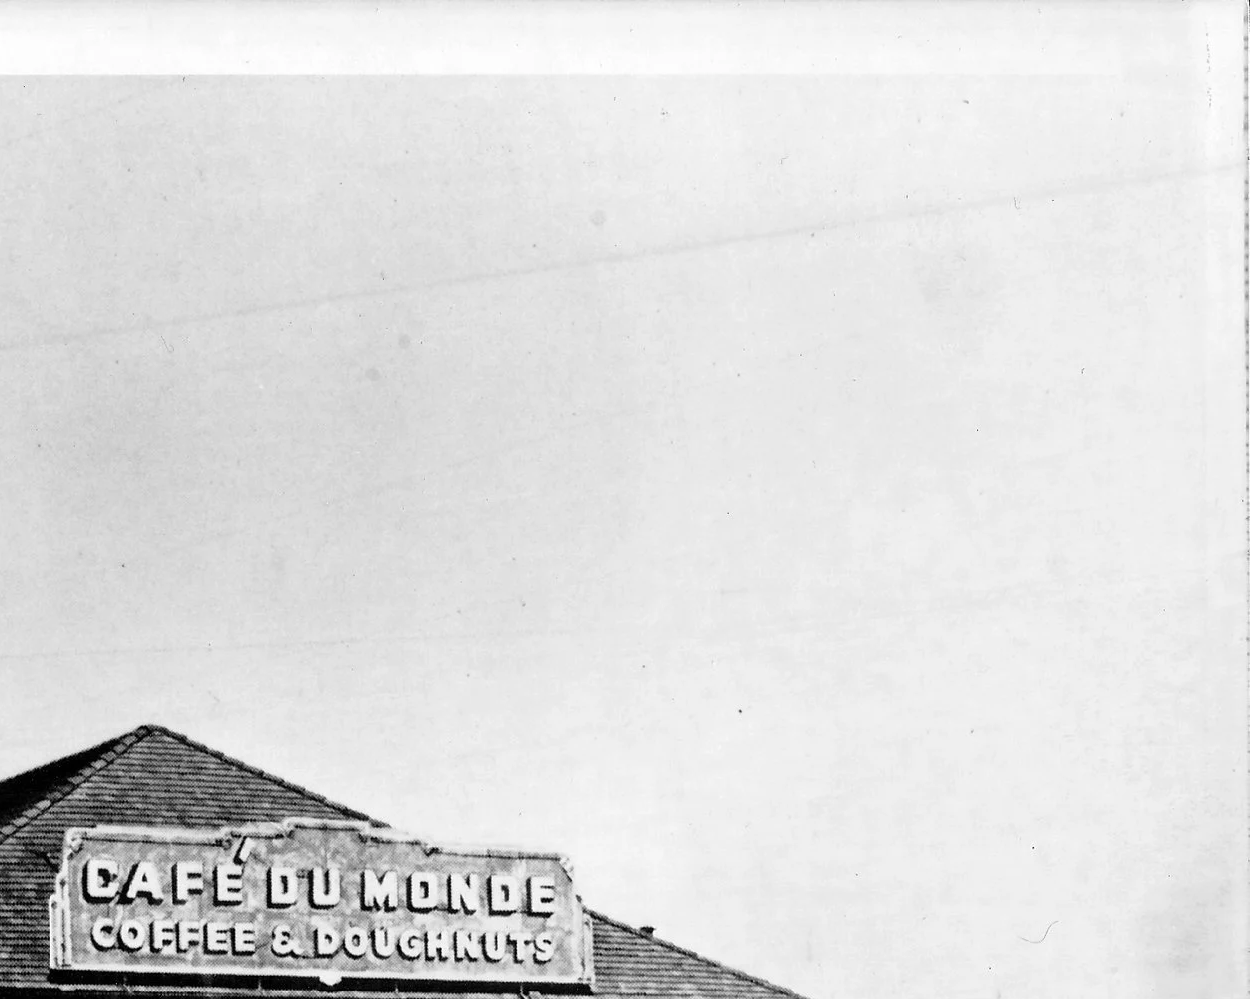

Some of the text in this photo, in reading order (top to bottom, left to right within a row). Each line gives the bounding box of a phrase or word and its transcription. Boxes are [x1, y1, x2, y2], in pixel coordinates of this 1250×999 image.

[266, 866, 341, 908] DU
[360, 869, 556, 915] MONDE
[91, 916, 556, 963] COFFEE & DOUGHNUTS
